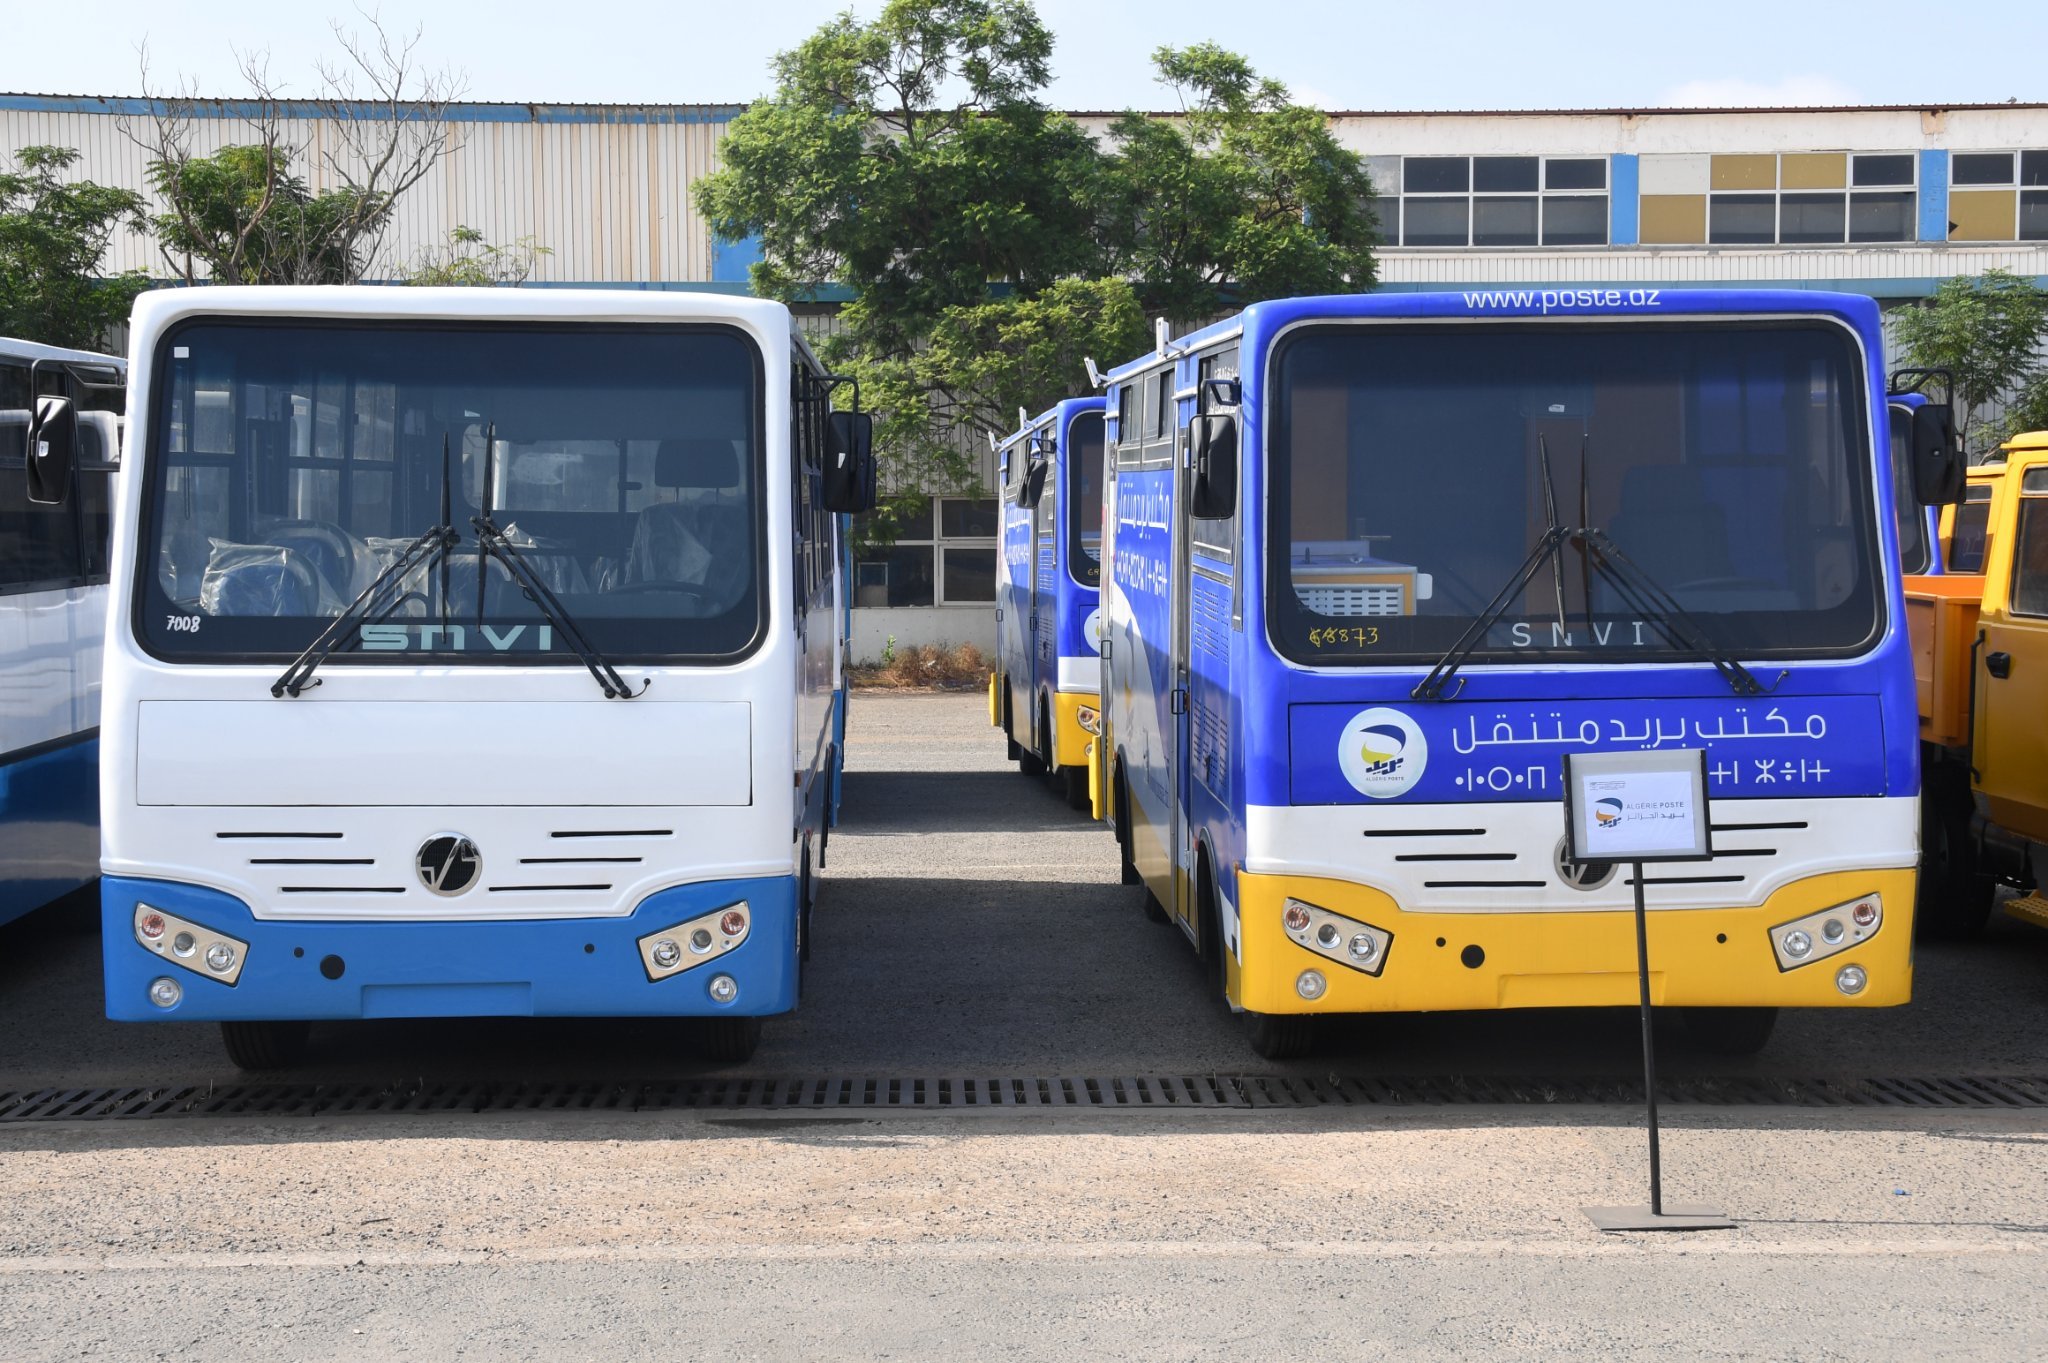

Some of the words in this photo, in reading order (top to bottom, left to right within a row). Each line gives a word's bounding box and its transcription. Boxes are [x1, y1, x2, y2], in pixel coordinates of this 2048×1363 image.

[1463, 289, 1661, 315] www.poste.dz
[166, 615, 201, 633] 7008
[1452, 712, 1600, 754] متنقل
[1609, 717, 1686, 750] بريد
[1695, 707, 1827, 748] مكتب
